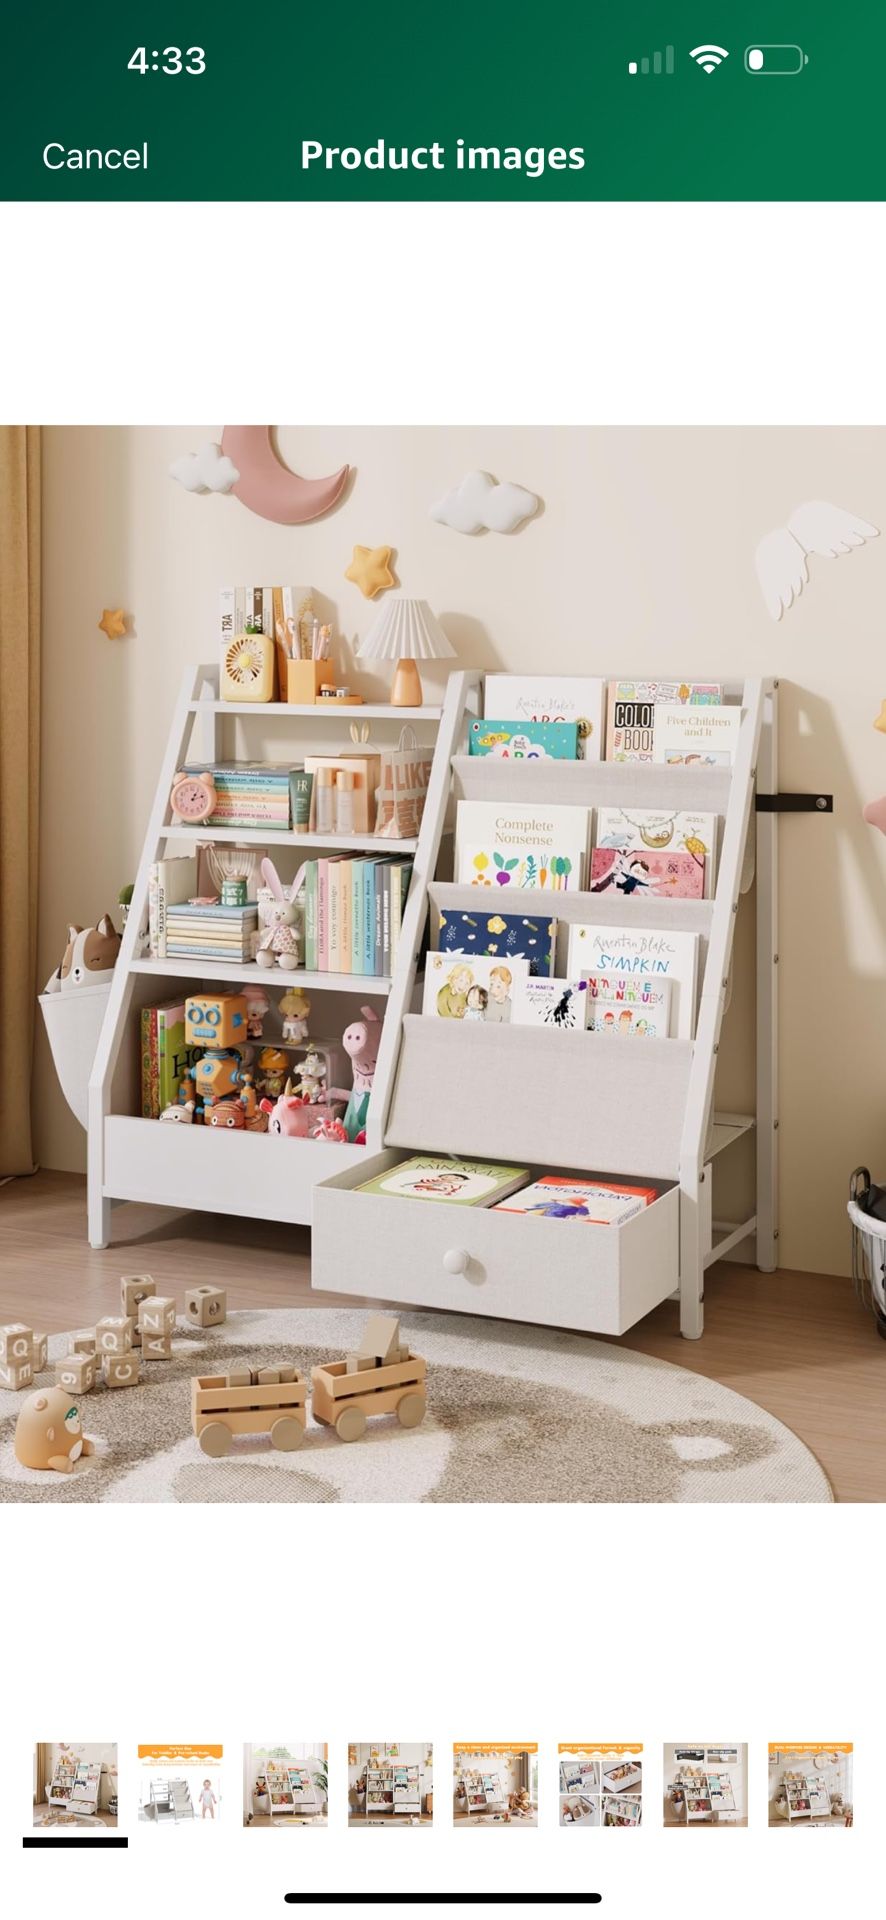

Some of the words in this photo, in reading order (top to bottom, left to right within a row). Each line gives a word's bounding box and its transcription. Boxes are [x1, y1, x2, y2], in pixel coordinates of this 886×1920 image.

[667, 716, 686, 726] Five
[688, 716, 731, 727] Children
[684, 728, 703, 737] and
[495, 818, 554, 833] Complete
[495, 831, 553, 846] Nonsense
[637, 936, 676, 954] Blake
[597, 954, 670, 973] SIMPKIN
[172, 1046, 206, 1079] HO
[12, 1338, 28, 1357] Q
[101, 1332, 118, 1351] Q
[148, 1337, 165, 1353] A
